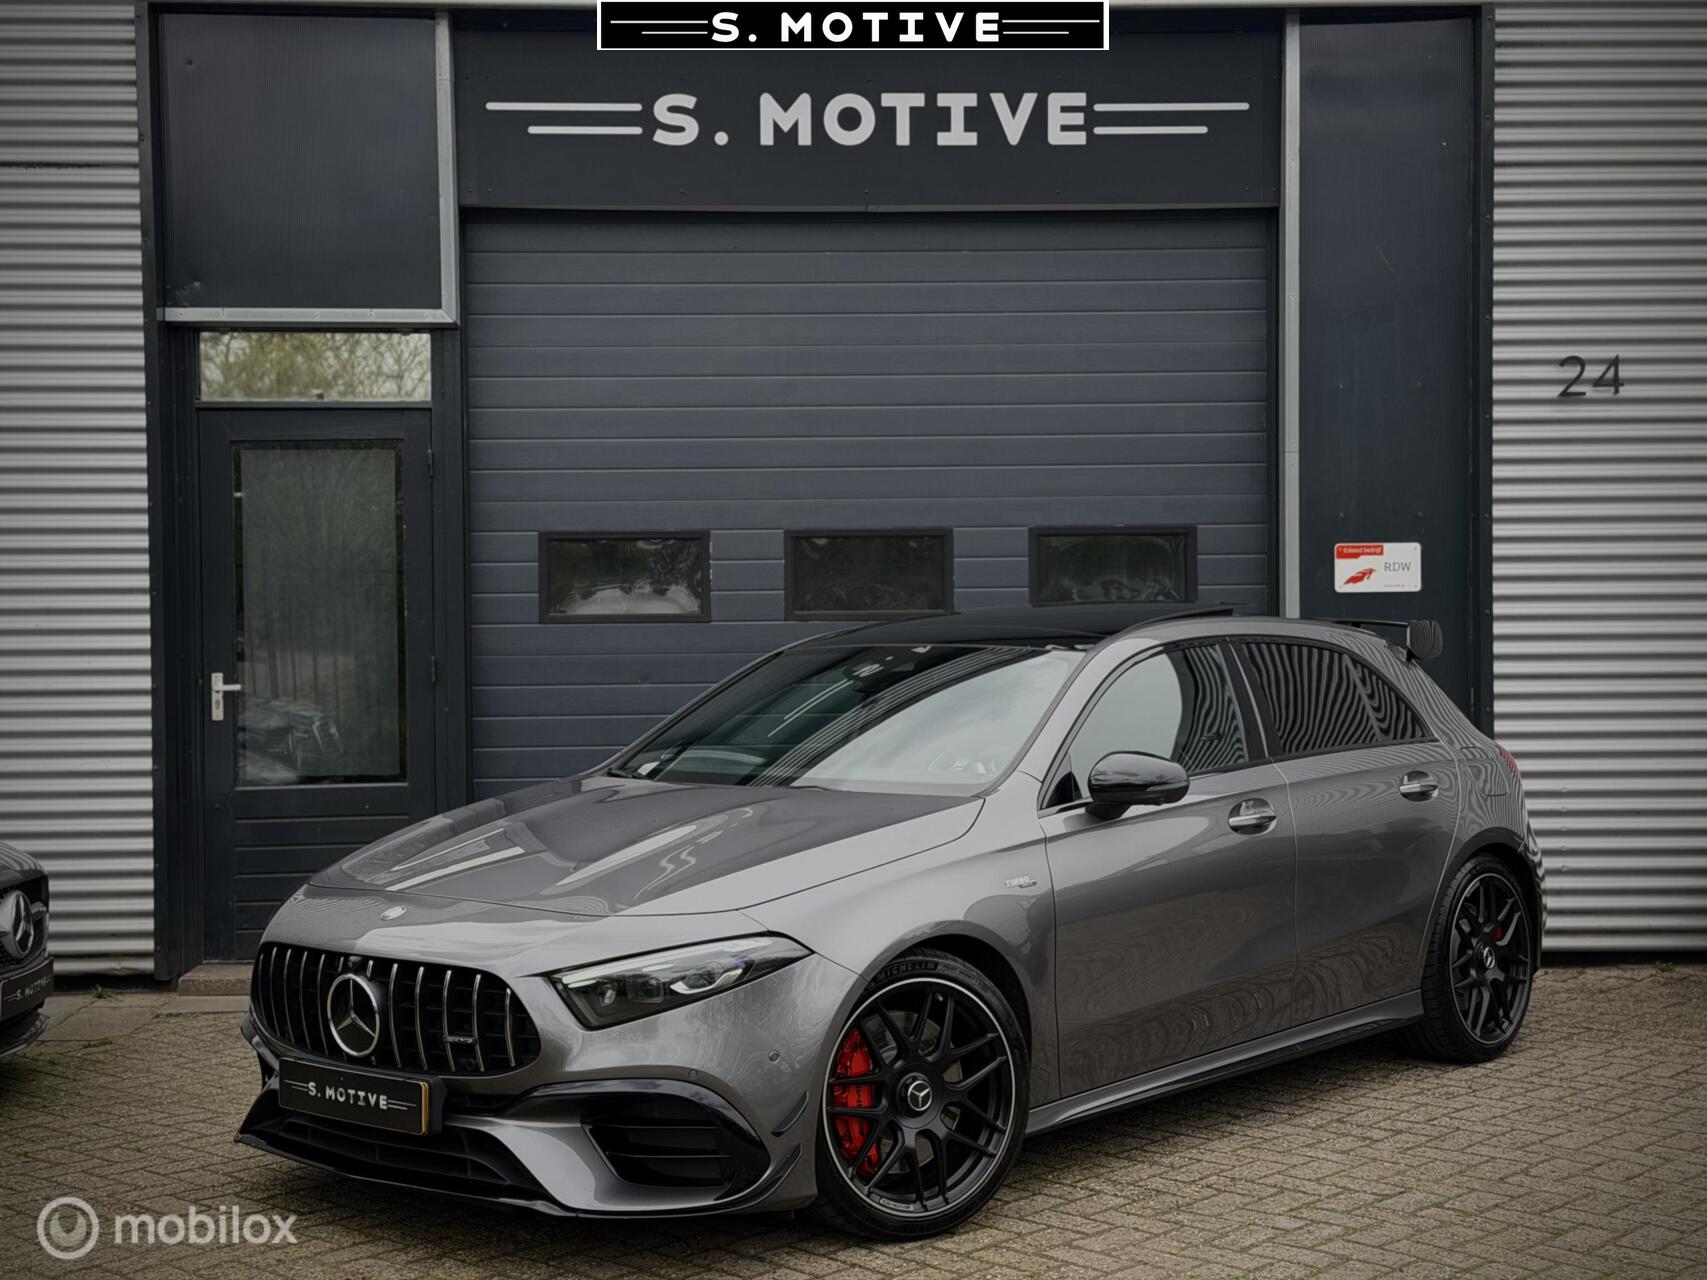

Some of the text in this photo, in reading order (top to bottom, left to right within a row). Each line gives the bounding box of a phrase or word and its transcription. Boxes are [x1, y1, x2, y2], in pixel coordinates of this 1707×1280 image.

[652, 92, 1088, 147] S. MOTIVE
[1557, 353, 1625, 397] 24
[1384, 561, 1411, 572] RDW
[307, 1081, 388, 1110] S. MOTIVE
